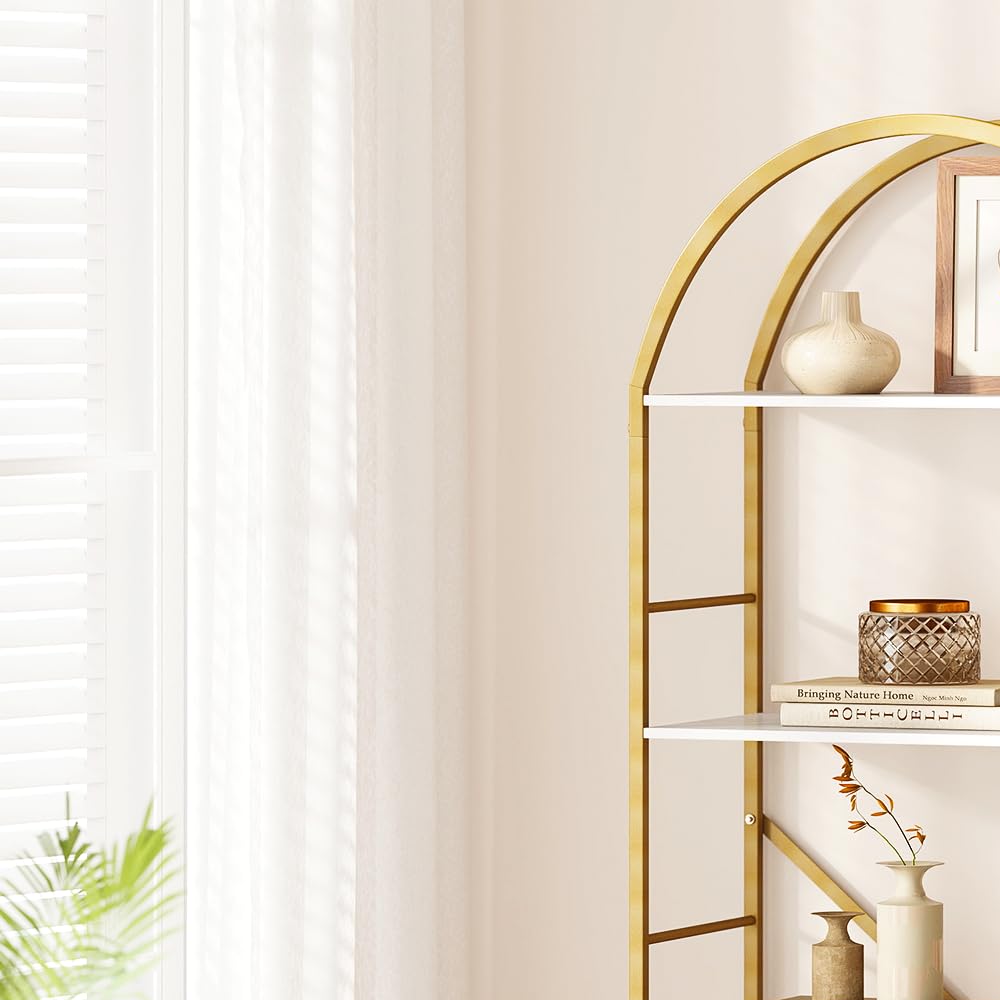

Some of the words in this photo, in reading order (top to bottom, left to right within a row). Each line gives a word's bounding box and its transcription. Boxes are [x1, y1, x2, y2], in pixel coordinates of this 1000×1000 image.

[797, 688, 842, 701] Bringing
[844, 689, 880, 700] Nature
[883, 690, 914, 701] Home
[828, 706, 963, 721] BOTTICELLI
